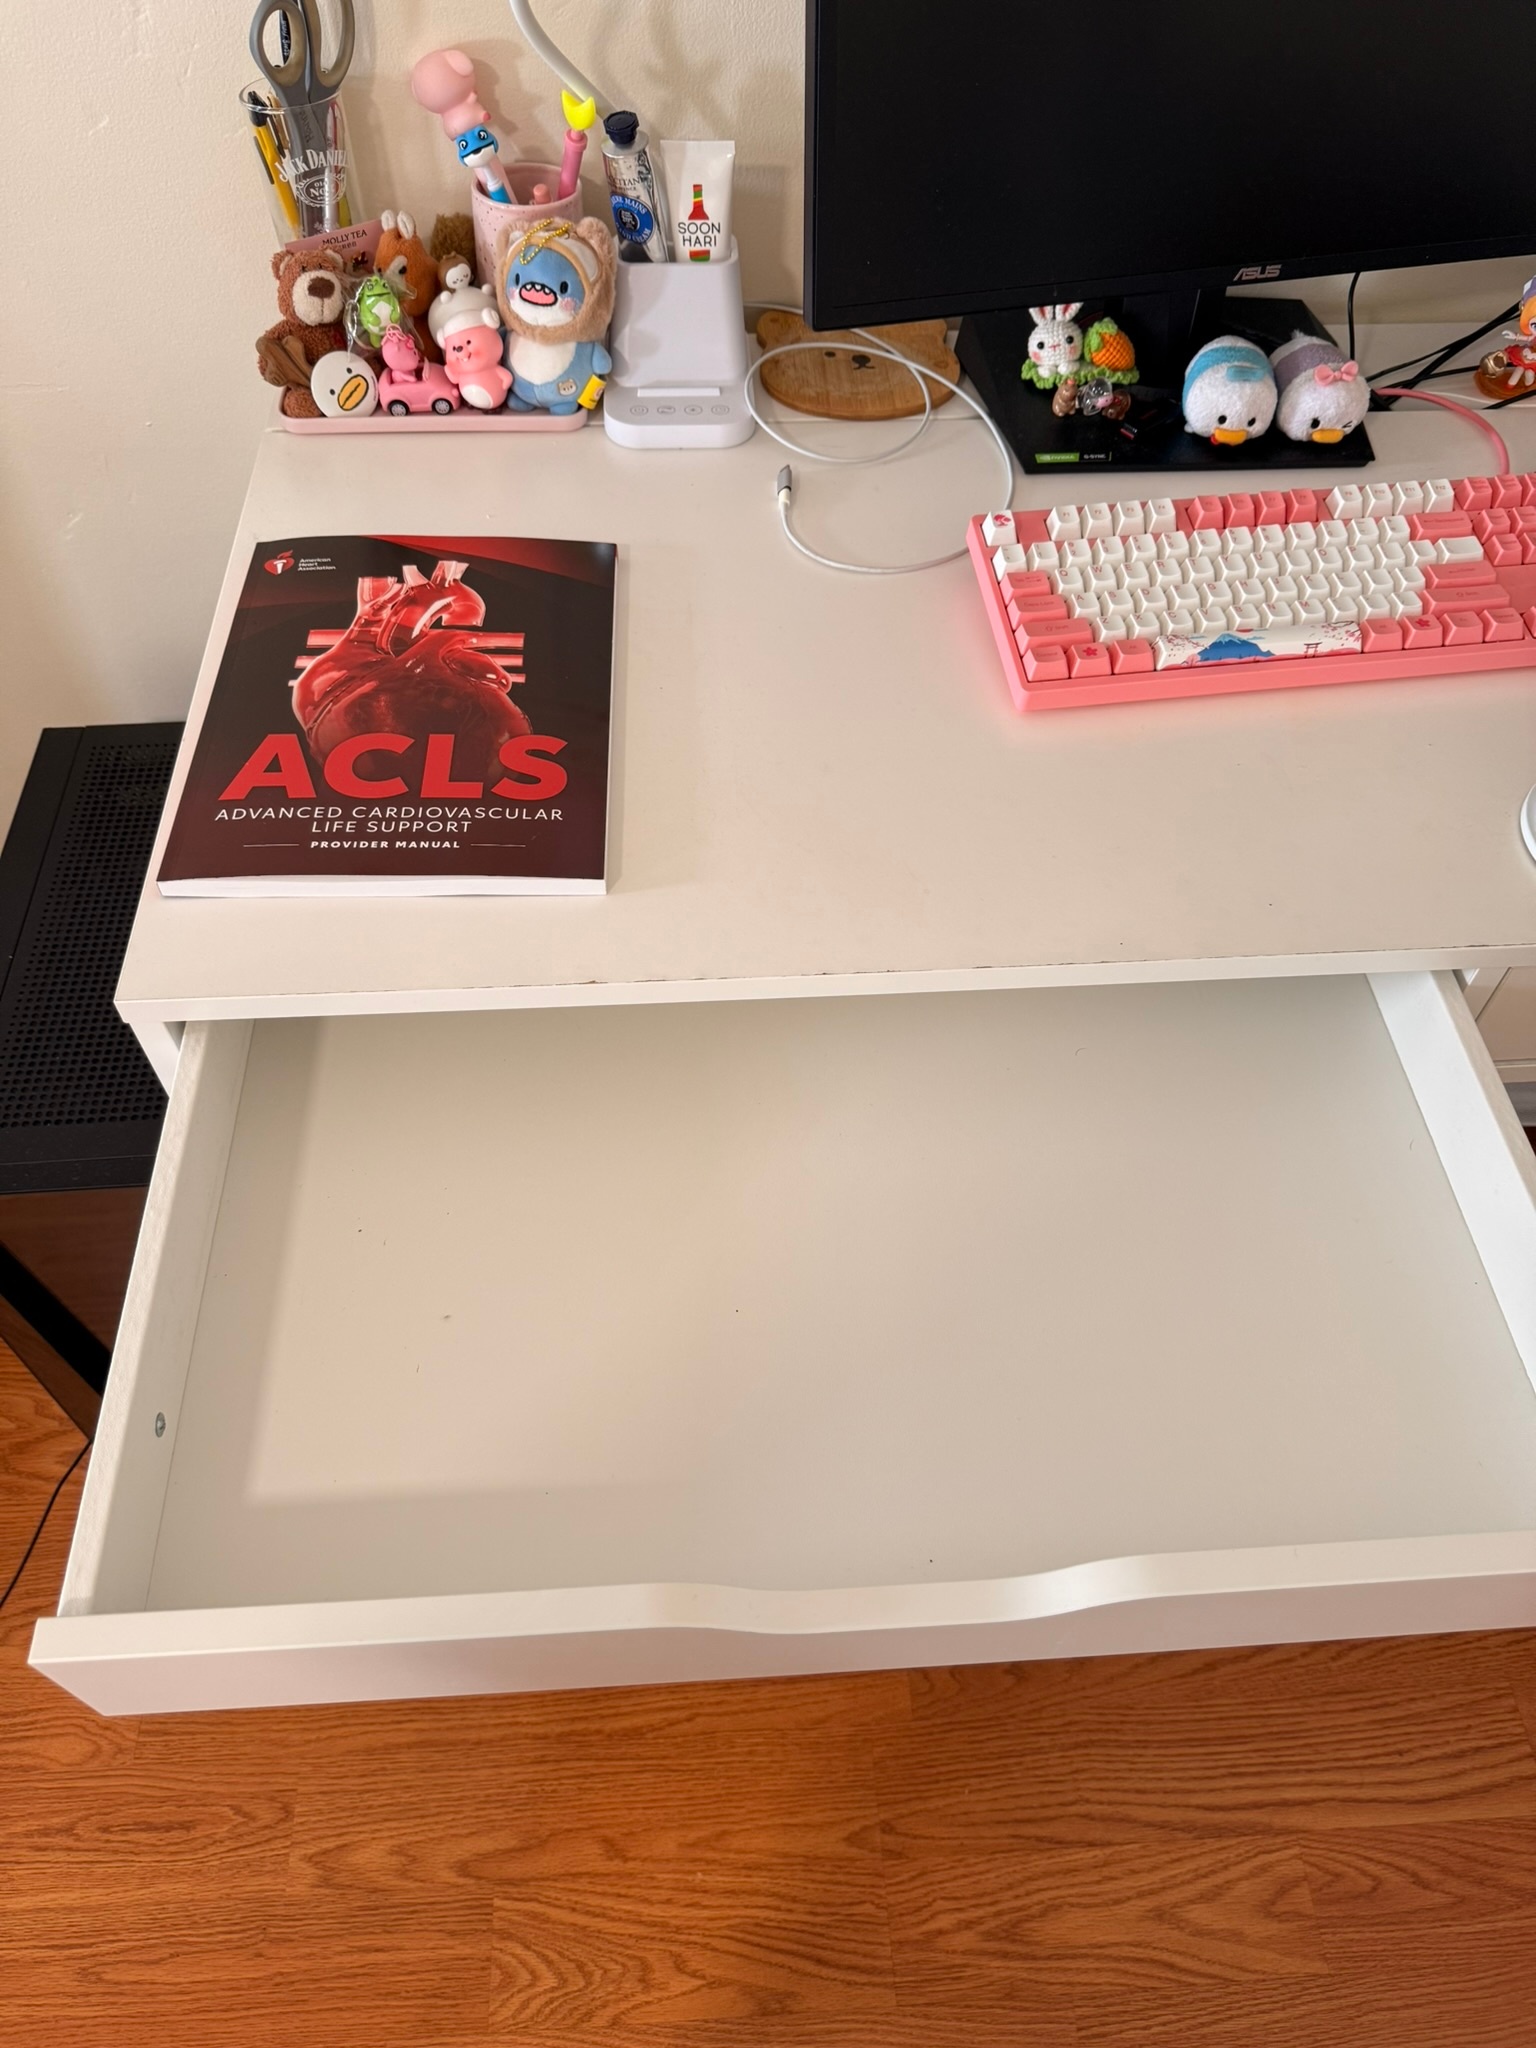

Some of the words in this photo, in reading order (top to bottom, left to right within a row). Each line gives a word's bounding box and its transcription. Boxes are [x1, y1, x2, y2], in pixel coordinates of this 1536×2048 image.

[678, 221, 721, 235] SOON
[322, 233, 350, 246] MOLLY
[350, 229, 368, 239] TEA
[682, 234, 717, 248] HARI
[1233, 264, 1282, 281] ASUS
[217, 732, 569, 801] ACLS
[214, 806, 343, 822] ADVANCED
[352, 806, 564, 821] CARDIOVASCULAR
[311, 820, 358, 833] LIFE
[366, 820, 473, 833] SUPPORT
[310, 840, 390, 849] PROVIDER
[395, 840, 460, 849] MANUAL
